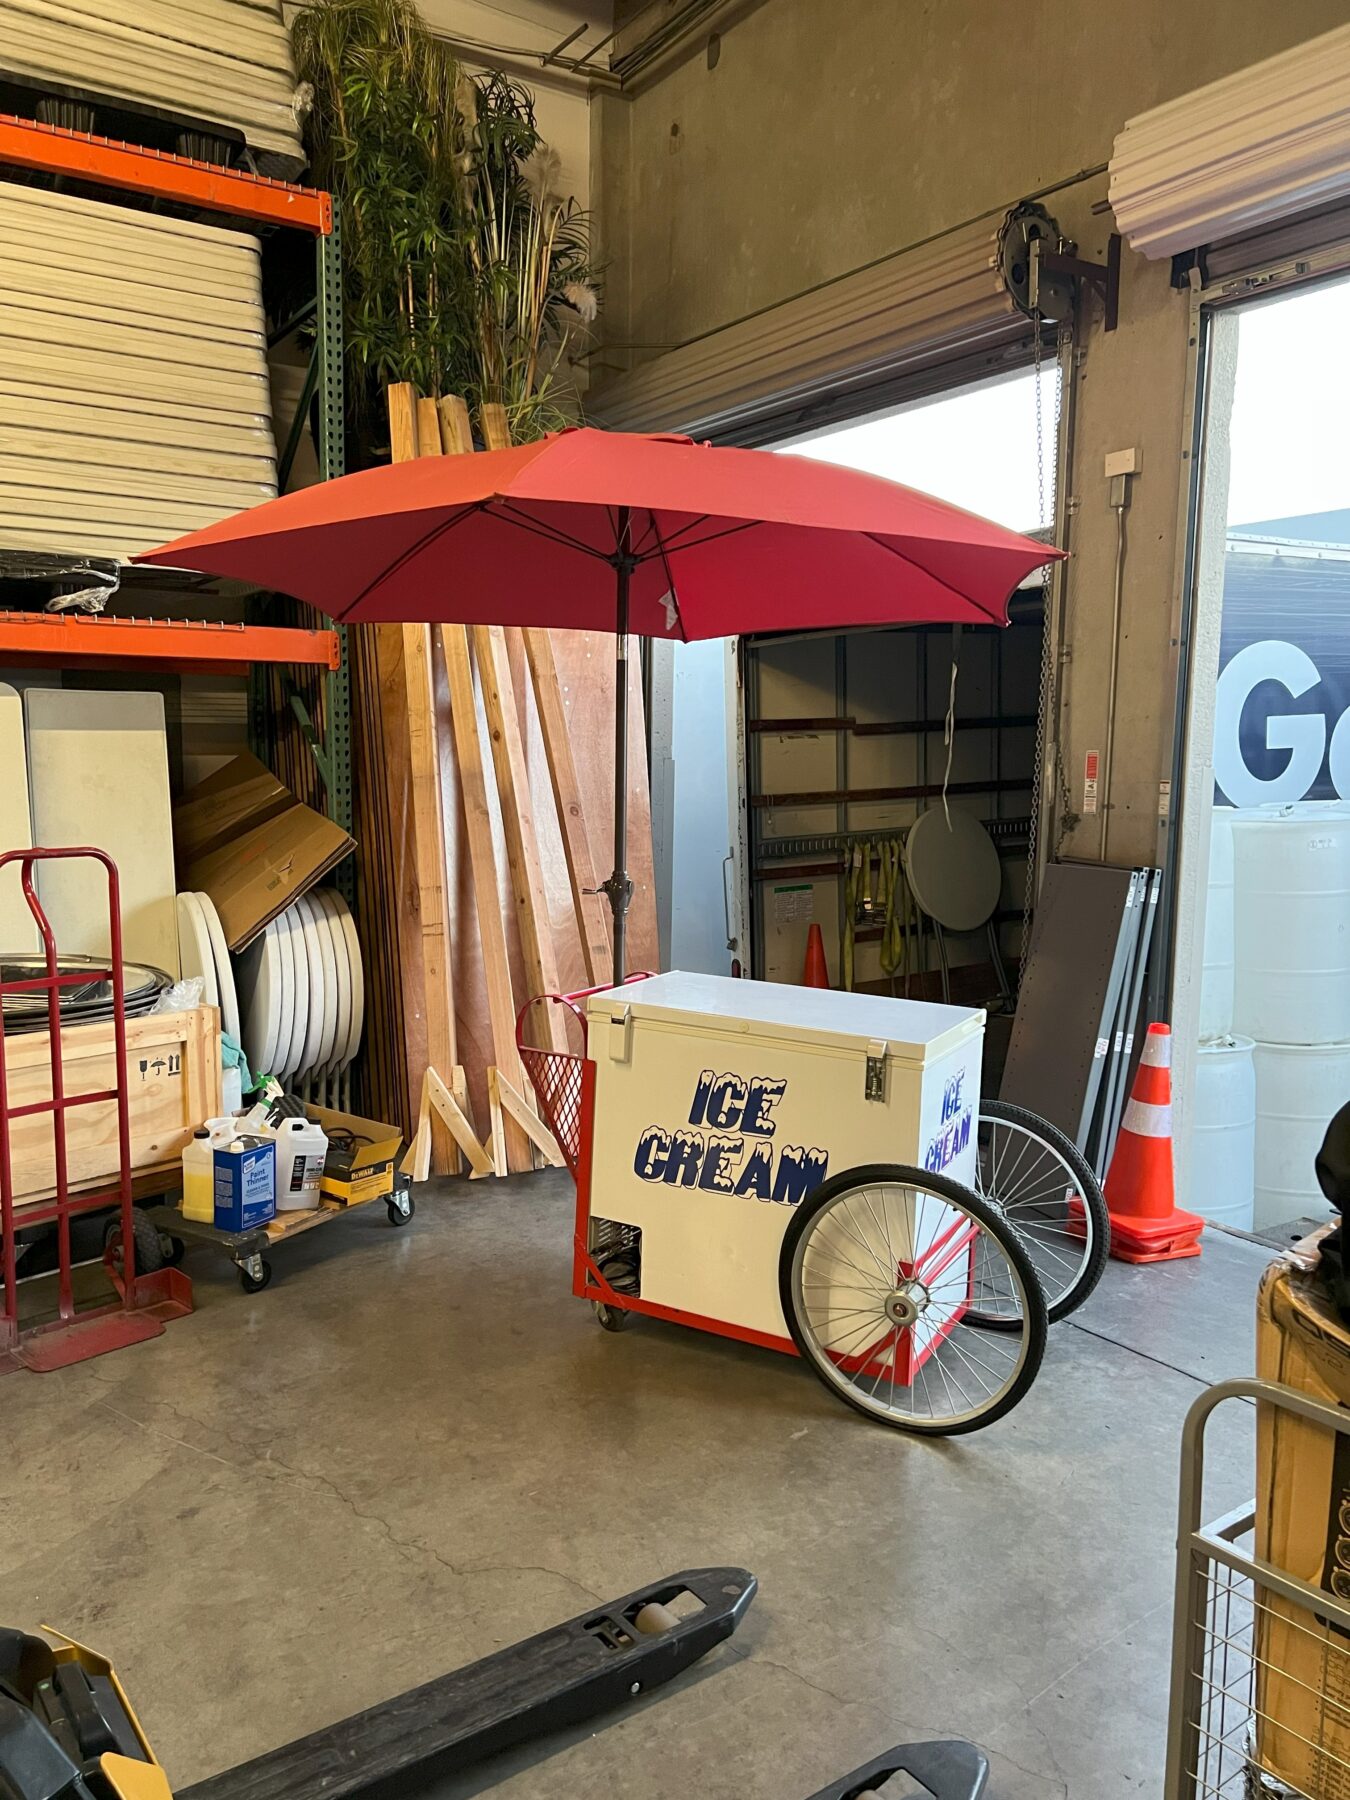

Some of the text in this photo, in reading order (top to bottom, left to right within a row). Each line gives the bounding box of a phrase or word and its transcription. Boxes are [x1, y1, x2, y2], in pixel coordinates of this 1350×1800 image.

[1212, 640, 1350, 808] G
[688, 1069, 787, 1139] ICE
[941, 1065, 966, 1126] ICE
[633, 1125, 829, 1207] CREAM
[924, 1104, 972, 1173] CREAM
[246, 1174, 269, 1187] Thinner
[250, 1169, 266, 1180] Paint
